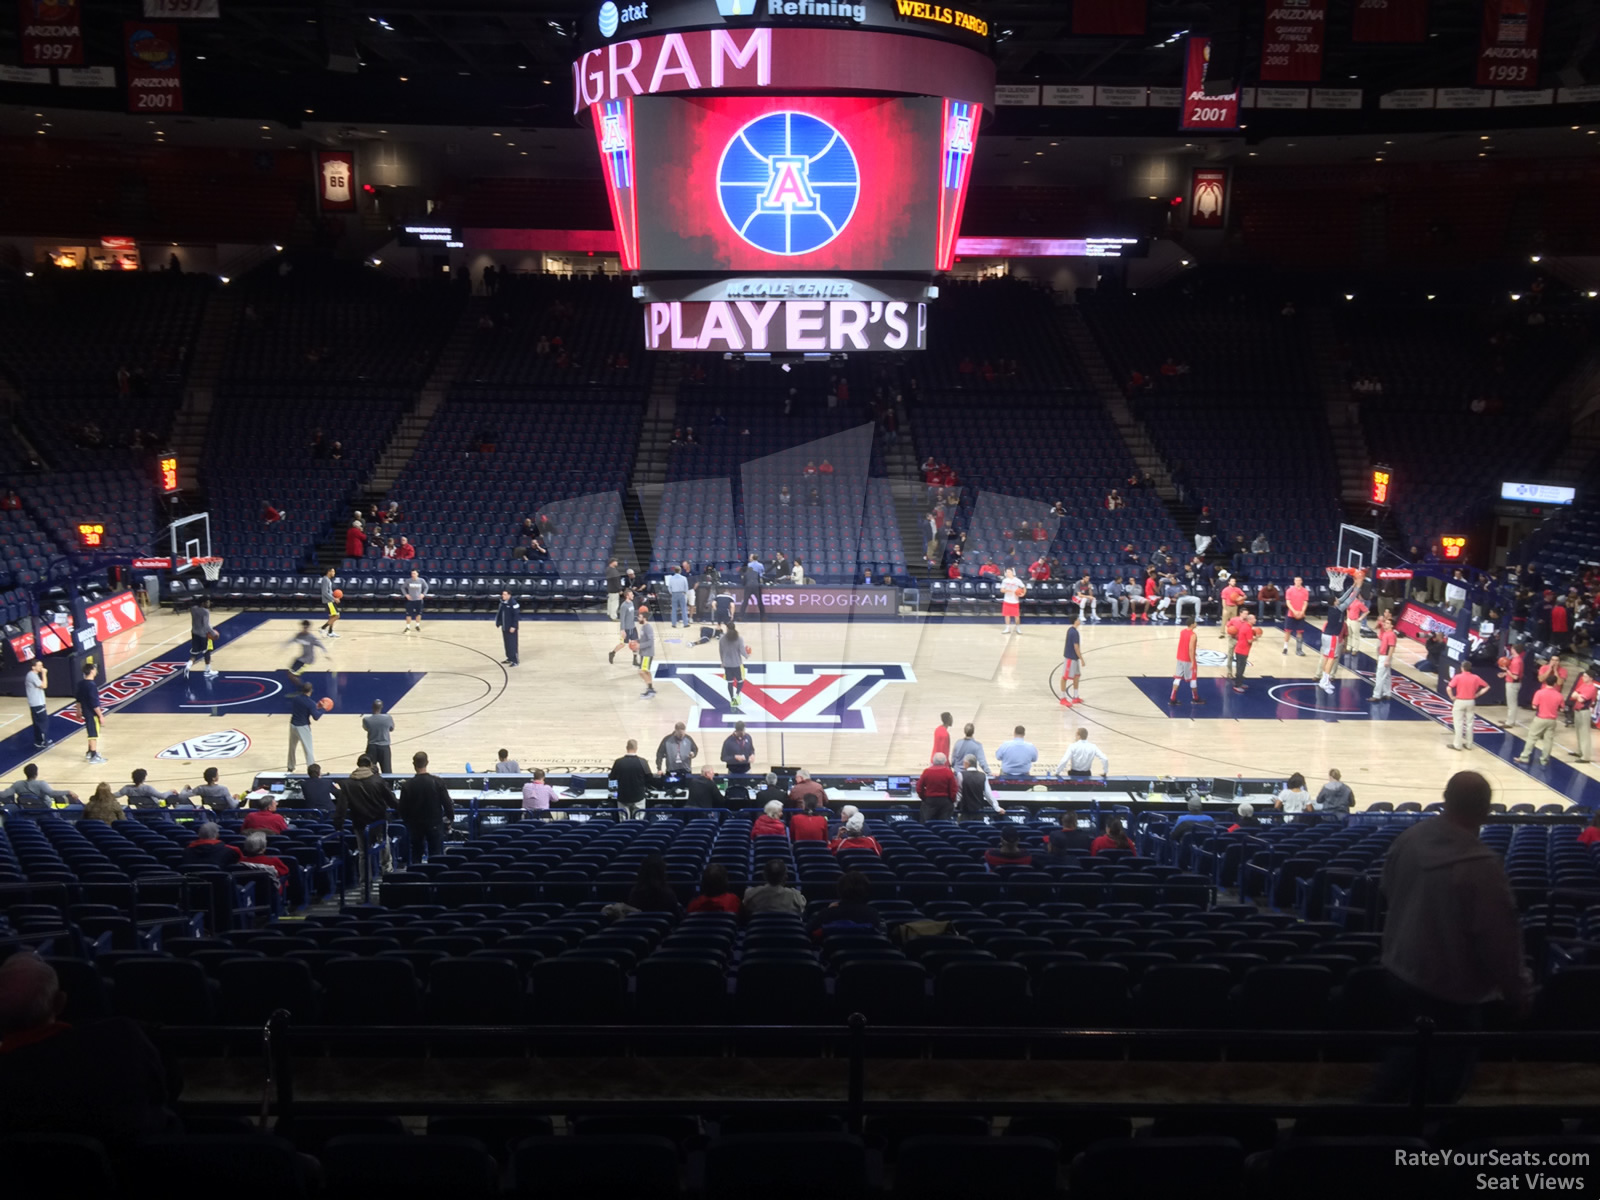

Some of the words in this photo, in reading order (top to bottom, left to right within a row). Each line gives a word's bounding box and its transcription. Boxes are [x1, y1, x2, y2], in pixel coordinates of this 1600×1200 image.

[620, 2, 648, 22] at&t
[768, 0, 867, 21] Refining
[1268, 9, 1324, 20] ARIZONA
[897, 0, 954, 25] WELLS
[954, 11, 989, 37] FARGO
[24, 25, 80, 37] ARIZONA
[1275, 26, 1313, 34] QUARTER
[33, 44, 73, 60] 1997
[1482, 48, 1538, 60] ARIZONA
[1264, 56, 1289, 66] 2005
[1488, 66, 1528, 81] 1993
[130, 78, 180, 88] ARIZONA
[137, 94, 173, 108] 2001
[1191, 108, 1228, 121] 2001
[330, 176, 345, 188] 86
[793, 283, 853, 298] CENTER
[651, 302, 912, 350] PLAYER'S
[799, 594, 888, 606] PROGRAM
